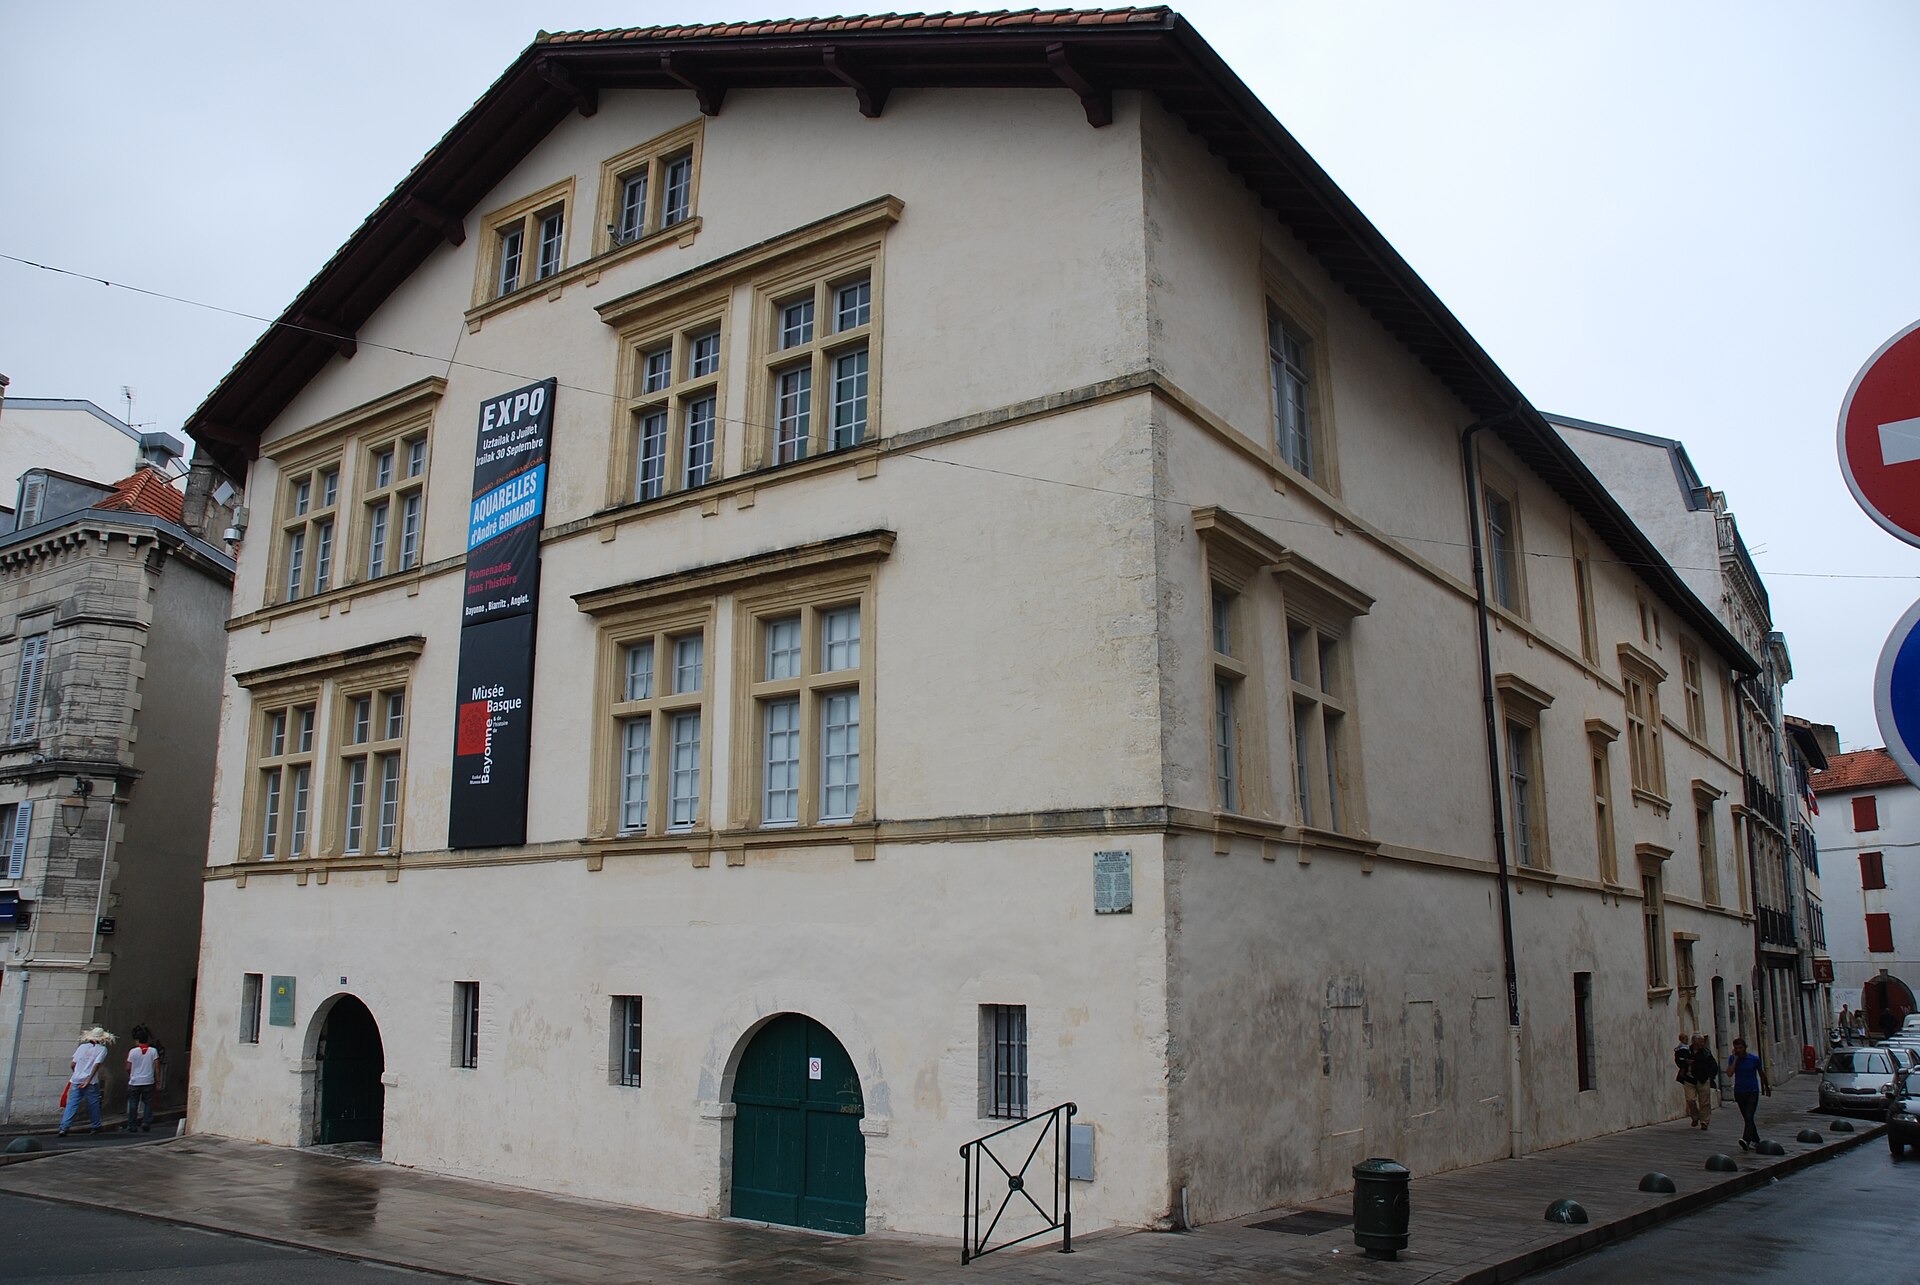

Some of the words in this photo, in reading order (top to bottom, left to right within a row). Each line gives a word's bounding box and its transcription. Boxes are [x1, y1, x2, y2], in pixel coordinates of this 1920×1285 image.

[482, 387, 545, 432] EXPO
[483, 433, 510, 450] Uztailak
[510, 431, 516, 442] 8
[516, 423, 538, 440] Juillet
[475, 451, 495, 467] Irailak
[496, 448, 506, 460] 30
[506, 438, 544, 457] Septembre
[472, 471, 537, 525] AQUARELLES
[470, 518, 497, 546] d'André
[498, 499, 536, 531] GRIMARD
[467, 583, 484, 595] dans
[485, 575, 518, 591] l'histoire
[468, 562, 512, 580] Promenades
[486, 698, 522, 714] Basque
[481, 718, 493, 784] Bayonne
